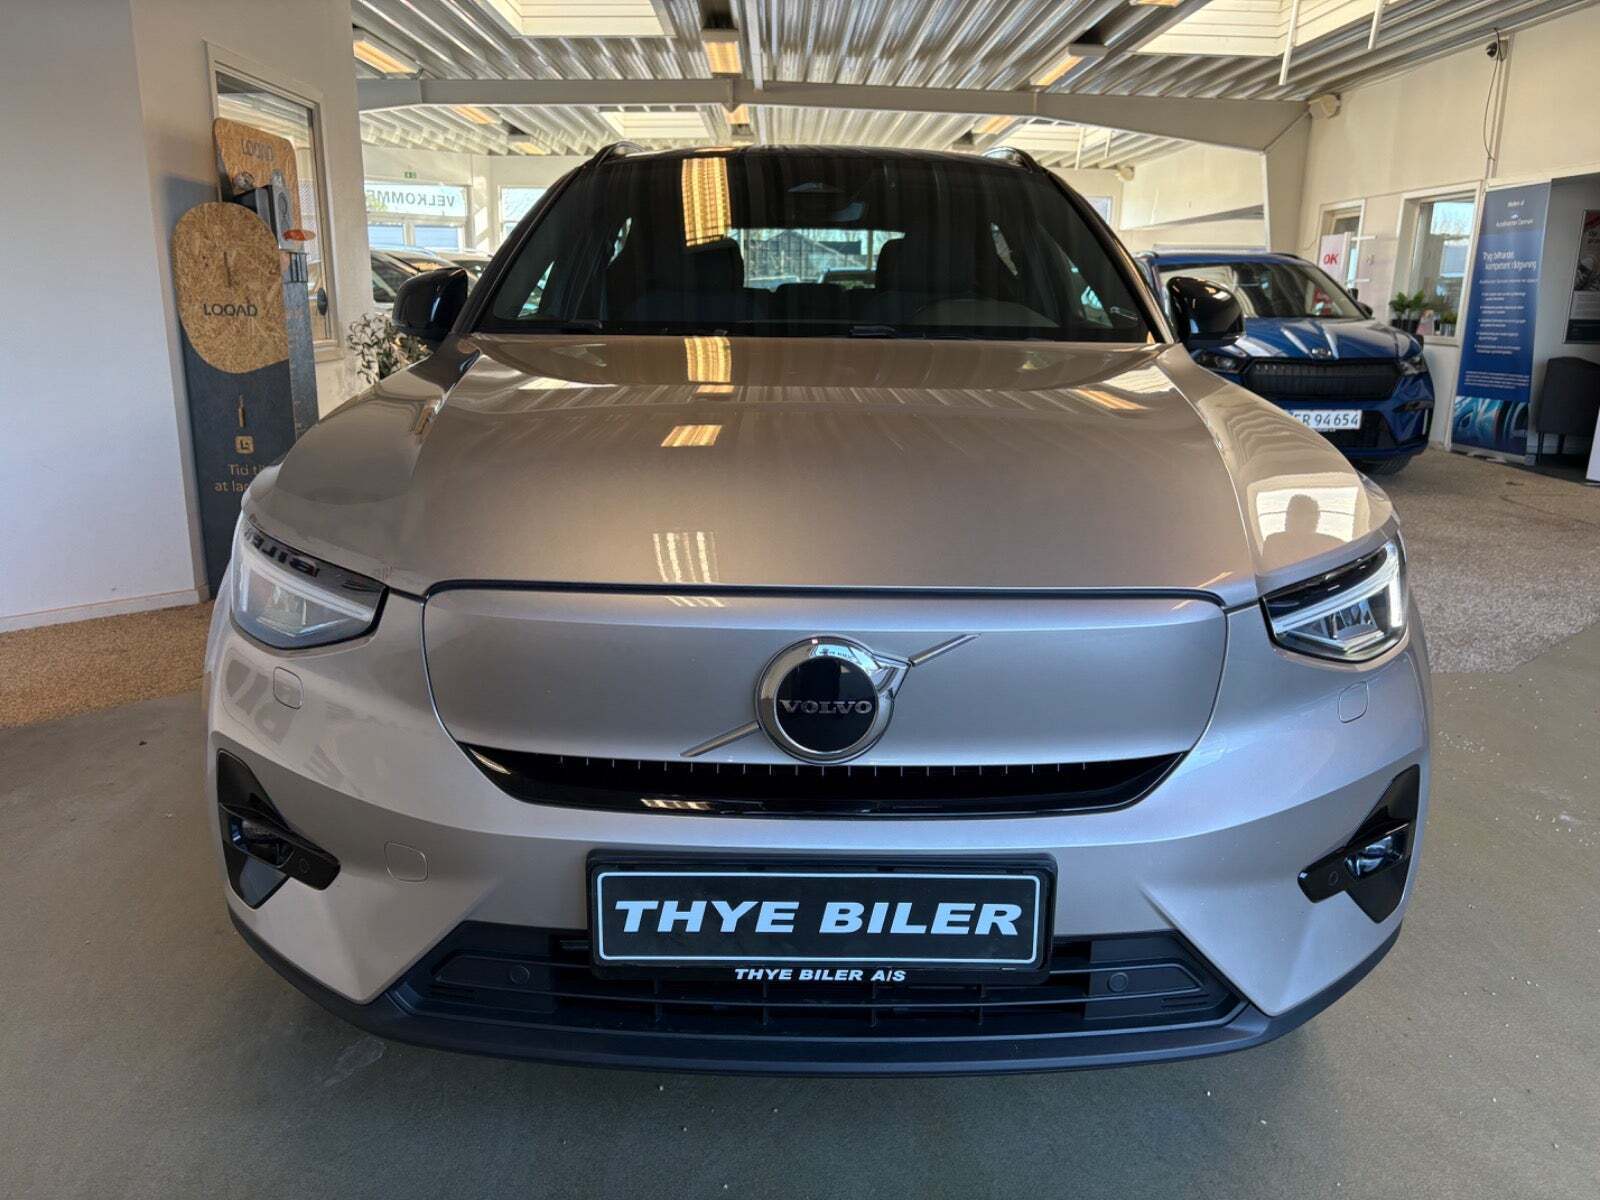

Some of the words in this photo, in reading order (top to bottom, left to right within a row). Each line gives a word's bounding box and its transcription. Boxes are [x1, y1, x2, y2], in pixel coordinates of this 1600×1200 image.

[1323, 253, 1339, 265] OK
[229, 463, 249, 476] Tid
[252, 463, 265, 475] ti
[214, 481, 229, 492] at
[779, 699, 873, 715] VOLVO
[614, 900, 799, 933] THYE
[819, 902, 1022, 936] BILER
[734, 969, 792, 981] THYE
[798, 969, 863, 982] BILER
[870, 970, 906, 982] A/S
